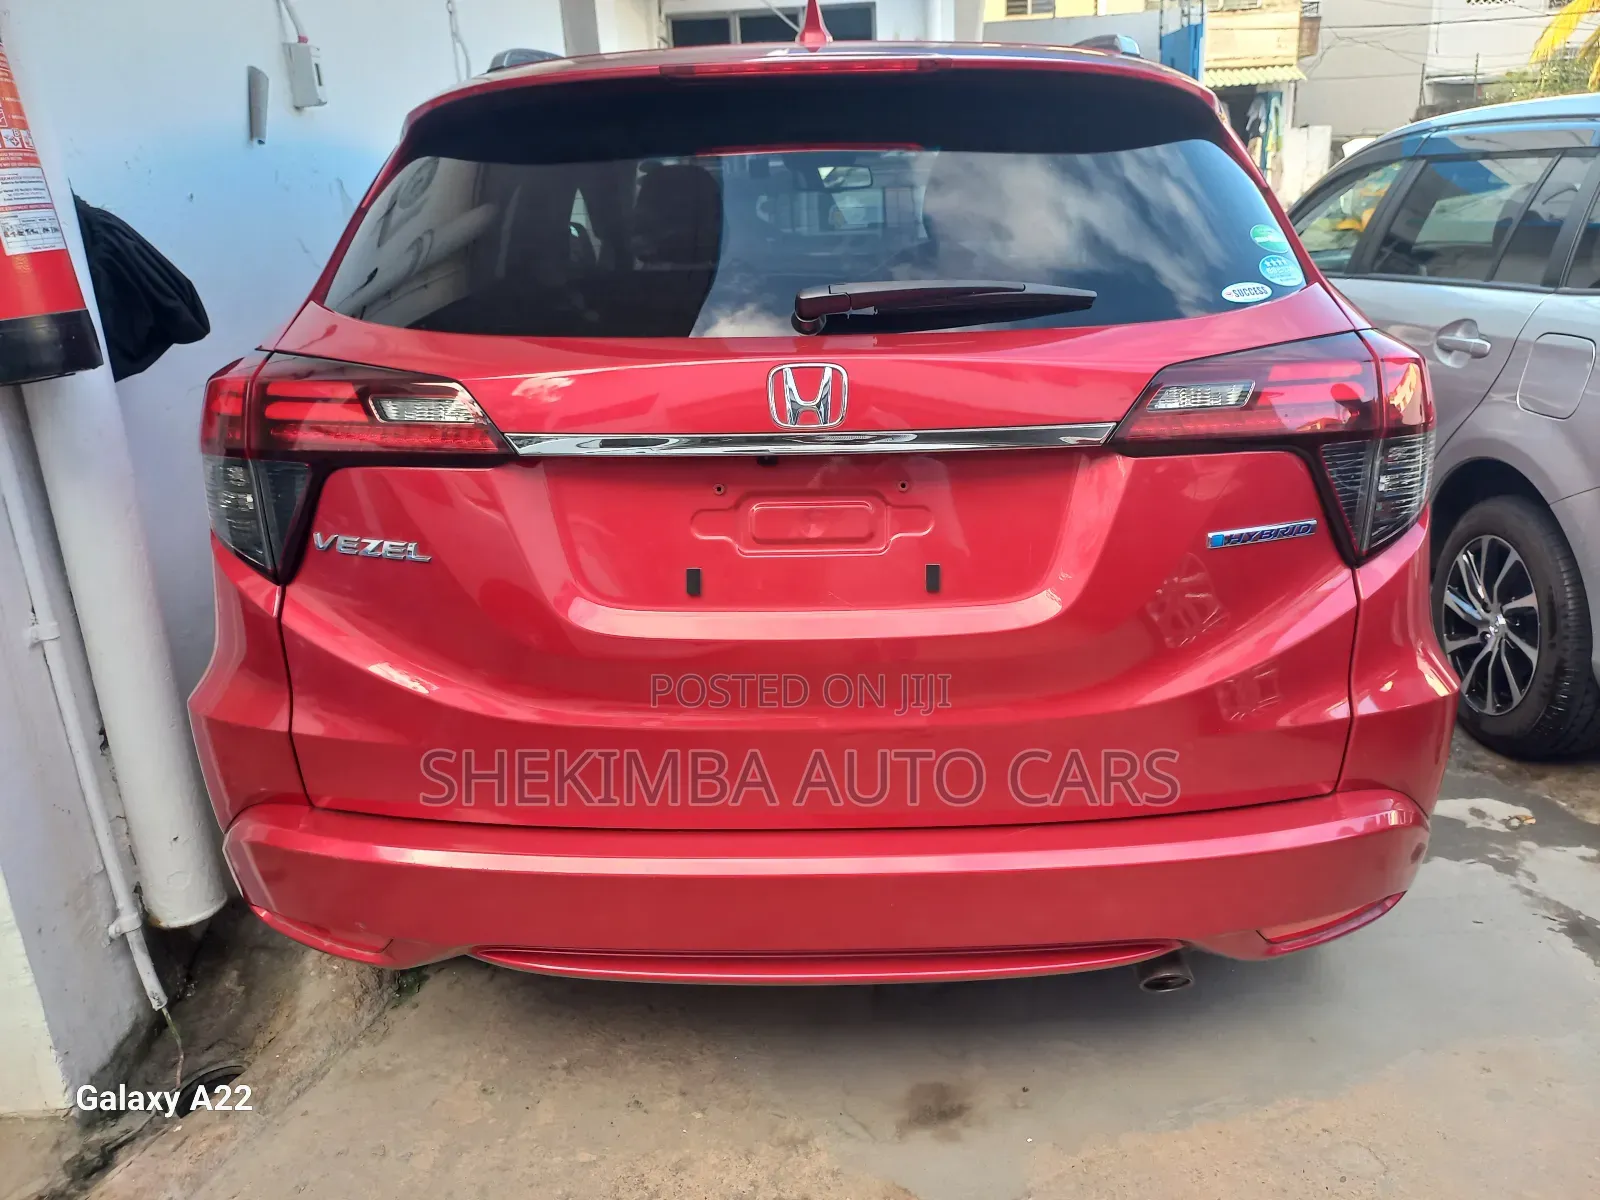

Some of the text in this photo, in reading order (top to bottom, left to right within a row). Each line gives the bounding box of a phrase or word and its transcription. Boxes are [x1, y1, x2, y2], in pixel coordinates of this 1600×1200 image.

[1232, 285, 1269, 298] SUCCESS
[1225, 522, 1313, 546] HYBRID
[313, 532, 432, 562] VEZEL
